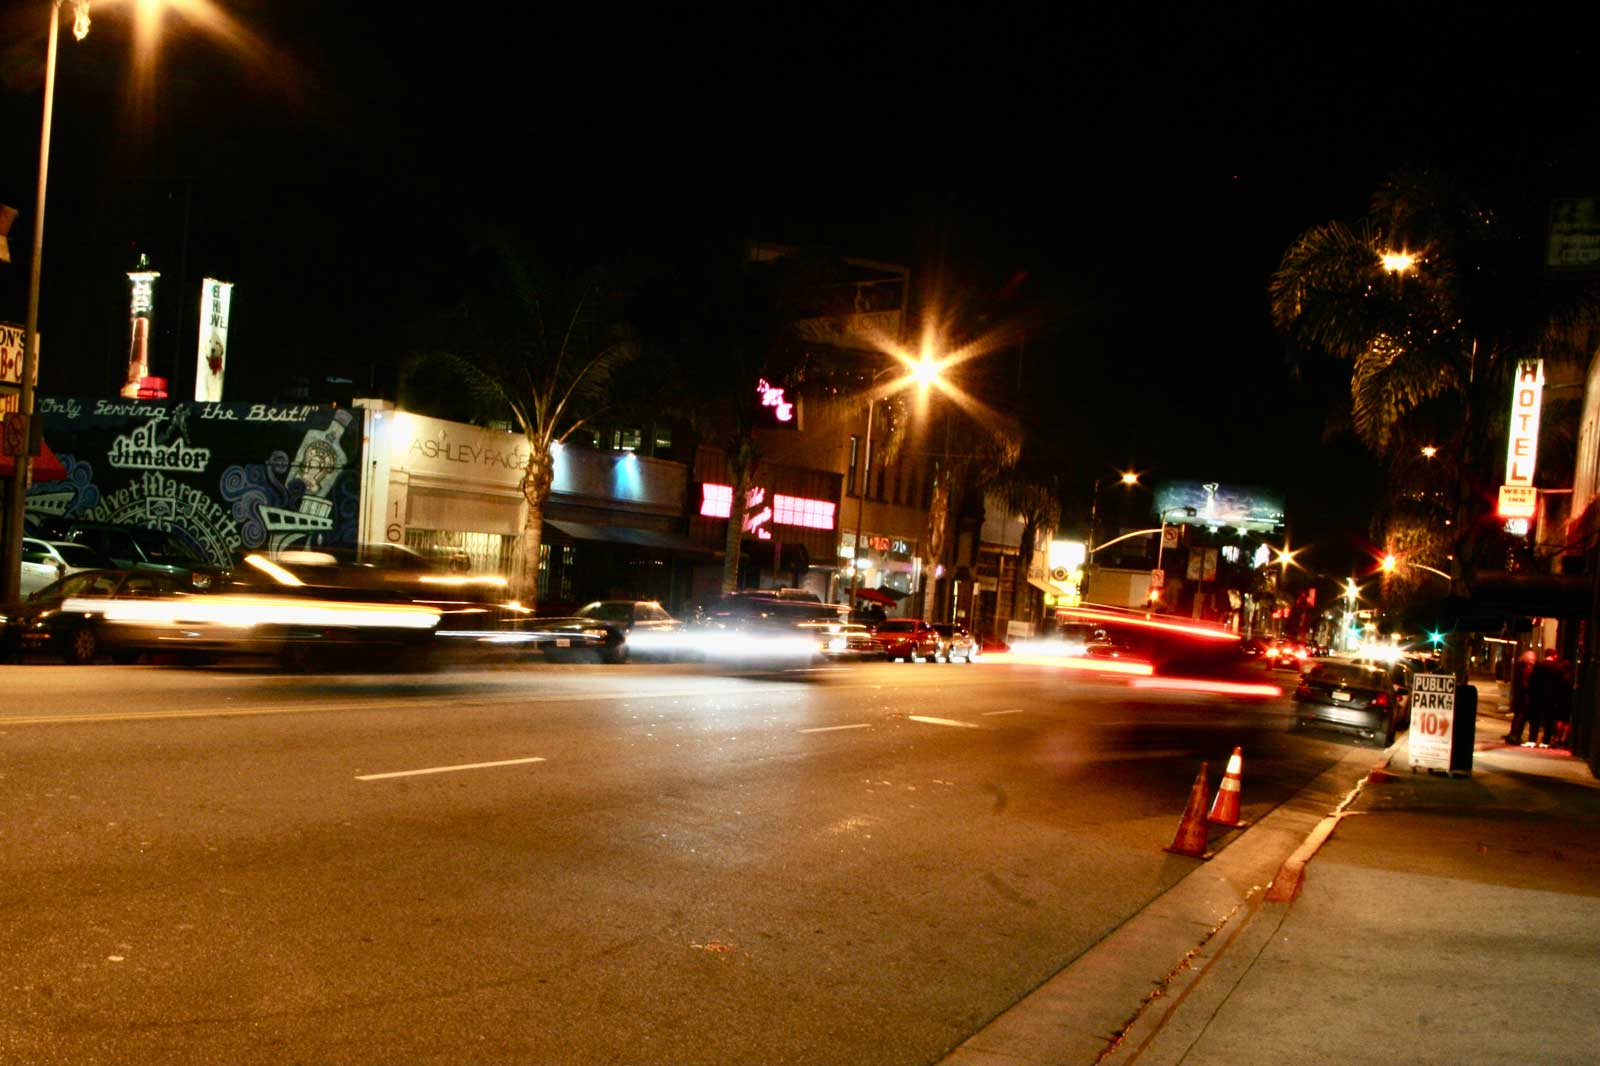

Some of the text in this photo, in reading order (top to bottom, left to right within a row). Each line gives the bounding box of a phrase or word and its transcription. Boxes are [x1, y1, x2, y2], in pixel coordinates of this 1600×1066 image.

[93, 400, 170, 420] Serving
[201, 403, 238, 420] the
[1511, 360, 1537, 481] HOTEL
[142, 471, 242, 552] Margarita
[1415, 677, 1454, 692] PUBLIC
